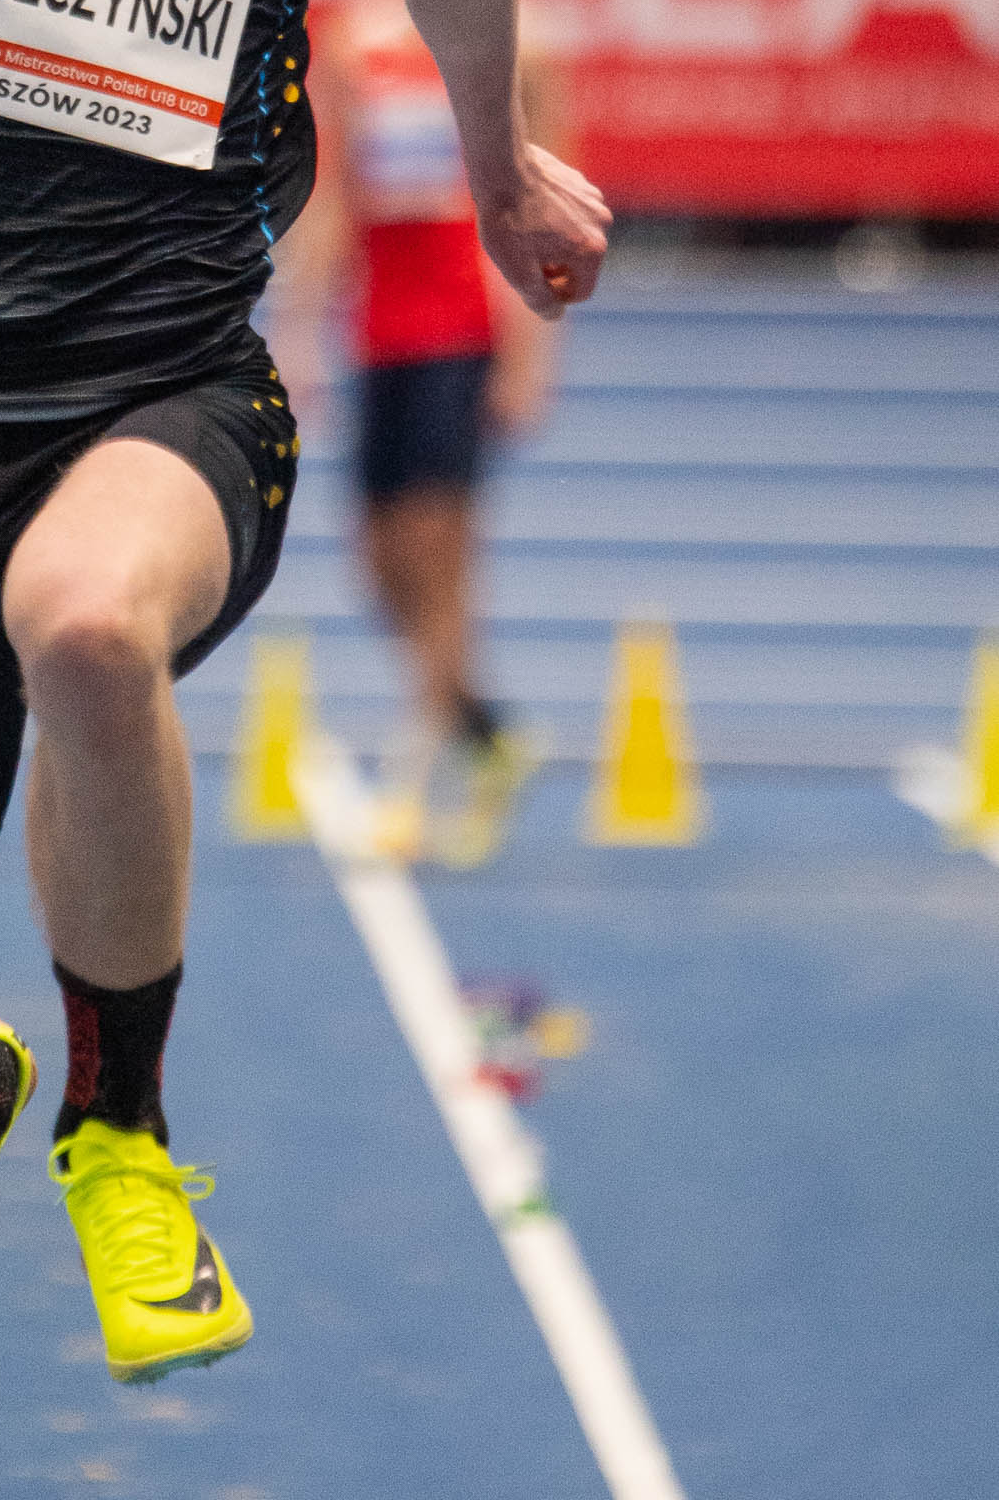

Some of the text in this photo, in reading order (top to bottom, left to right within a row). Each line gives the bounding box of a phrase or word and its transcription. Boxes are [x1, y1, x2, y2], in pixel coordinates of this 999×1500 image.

[4, 50, 99, 85] Mistrzostwa
[102, 75, 148, 100] Polski
[151, 89, 177, 108] U18
[179, 97, 209, 118] U20
[85, 101, 153, 135] 2023
